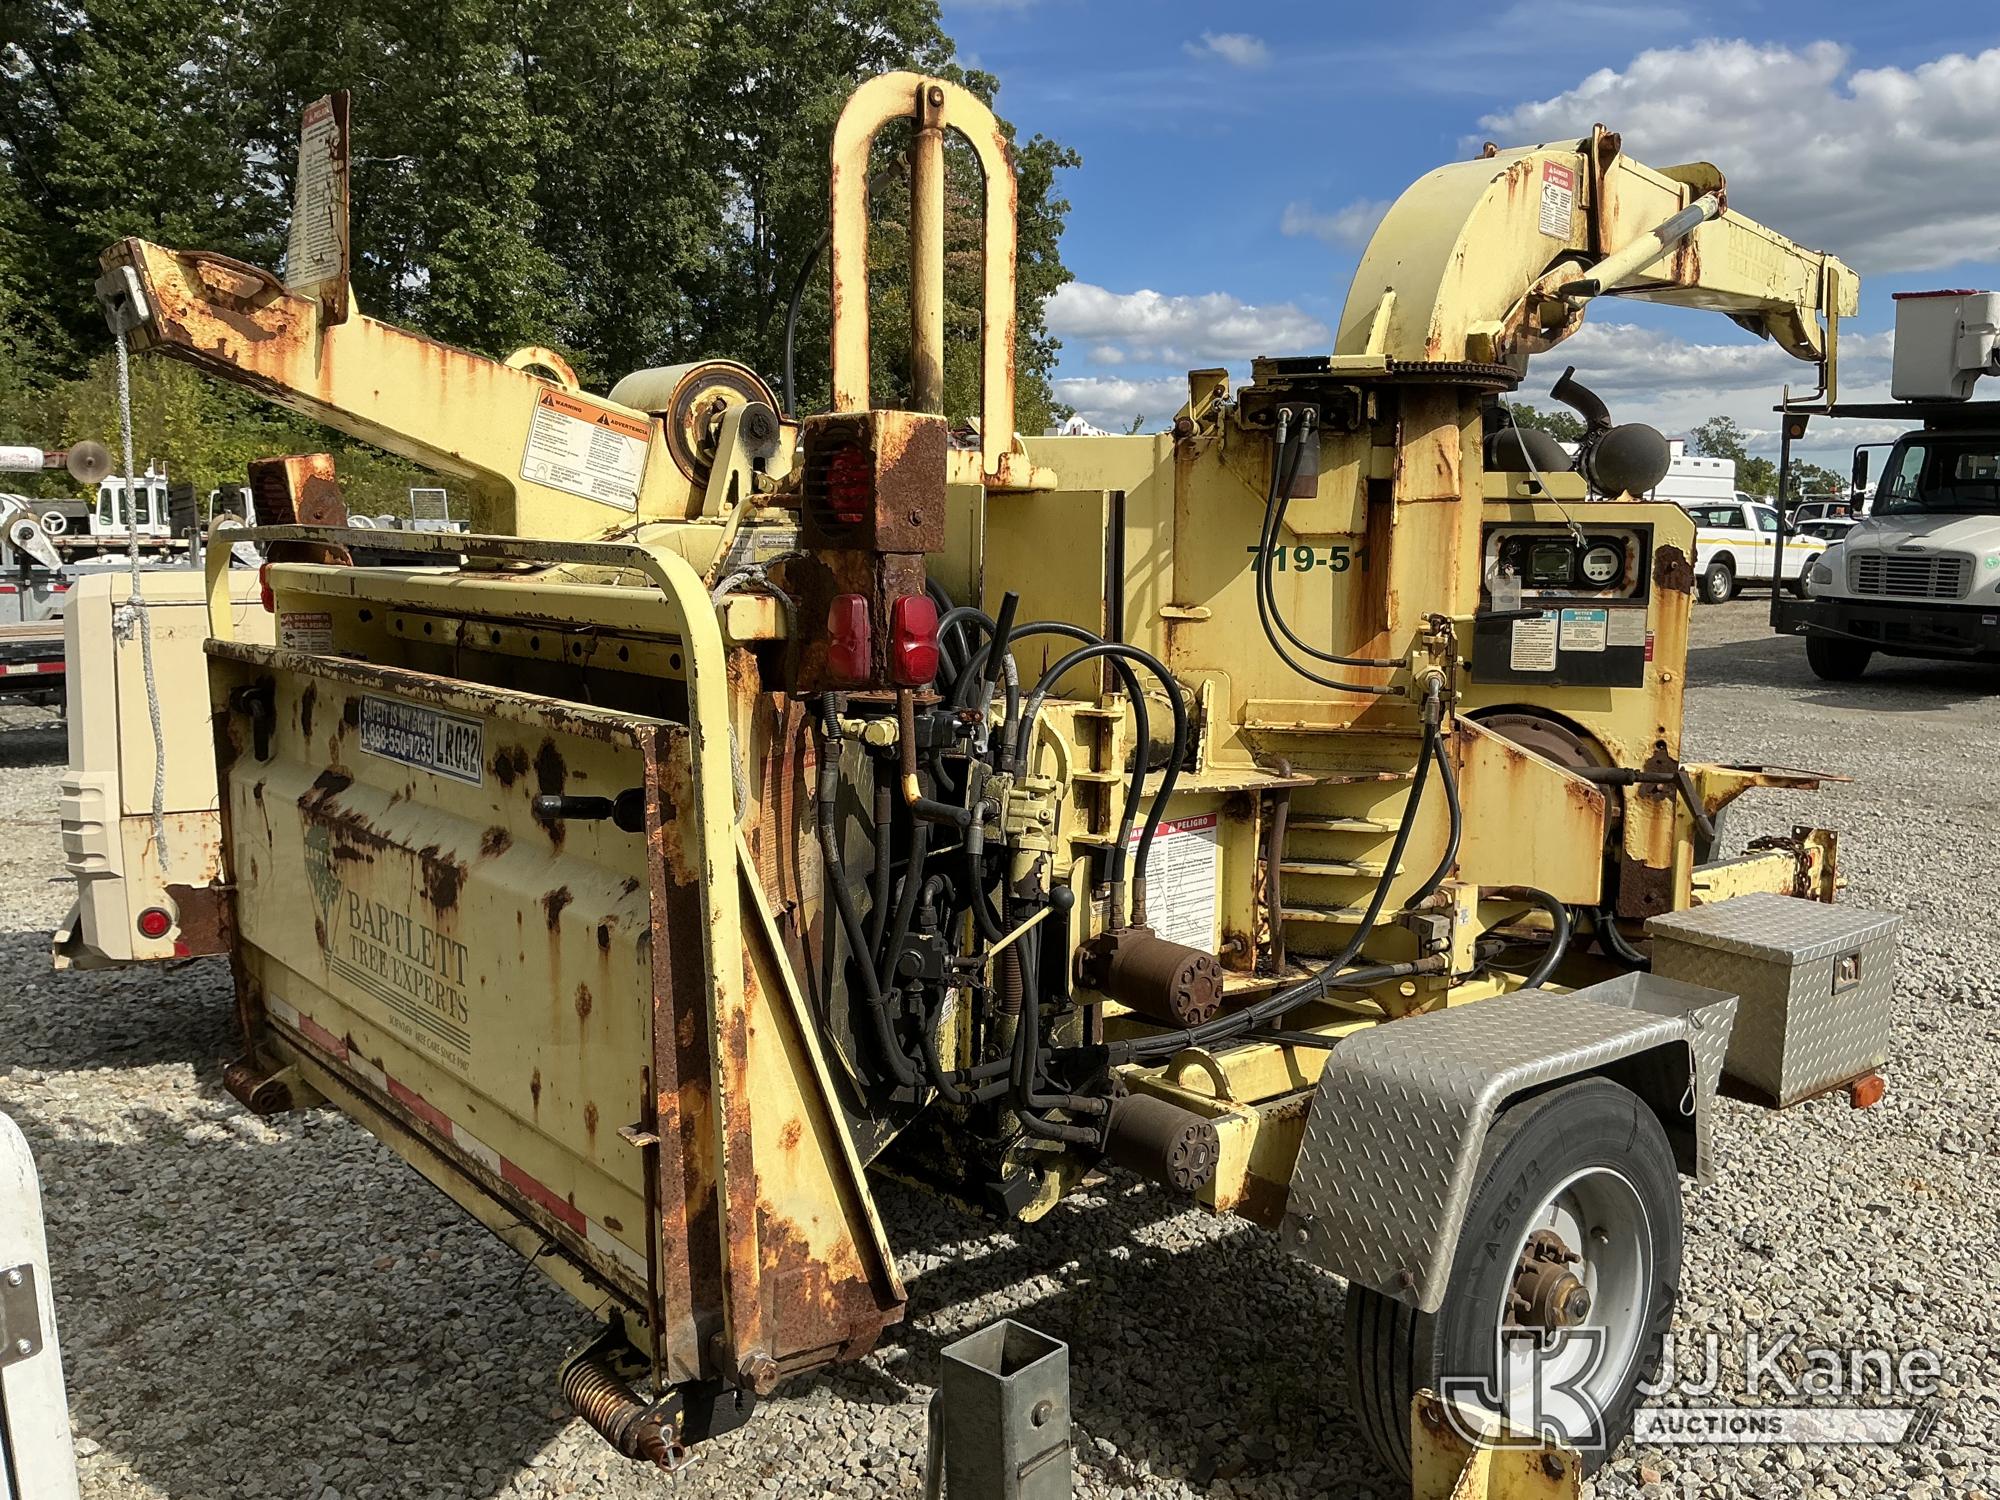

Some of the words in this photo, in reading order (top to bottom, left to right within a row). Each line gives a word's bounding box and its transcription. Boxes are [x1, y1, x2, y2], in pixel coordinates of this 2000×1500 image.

[555, 400, 582, 413] WARNING
[610, 419, 648, 436] ADVERTENCIA
[1247, 545, 1370, 572] 719-51
[363, 698, 389, 724] SAFETY
[390, 705, 398, 727] IS
[400, 706, 412, 730] MY
[412, 711, 432, 737] GOAL
[361, 720, 433, 765] 1-888-550-7233
[438, 720, 478, 773] LR032
[1177, 817, 1208, 829] PELIGRO
[347, 888, 470, 988] BARTLETT
[349, 933, 389, 980] TREE
[392, 957, 470, 1026] EXPERTS
